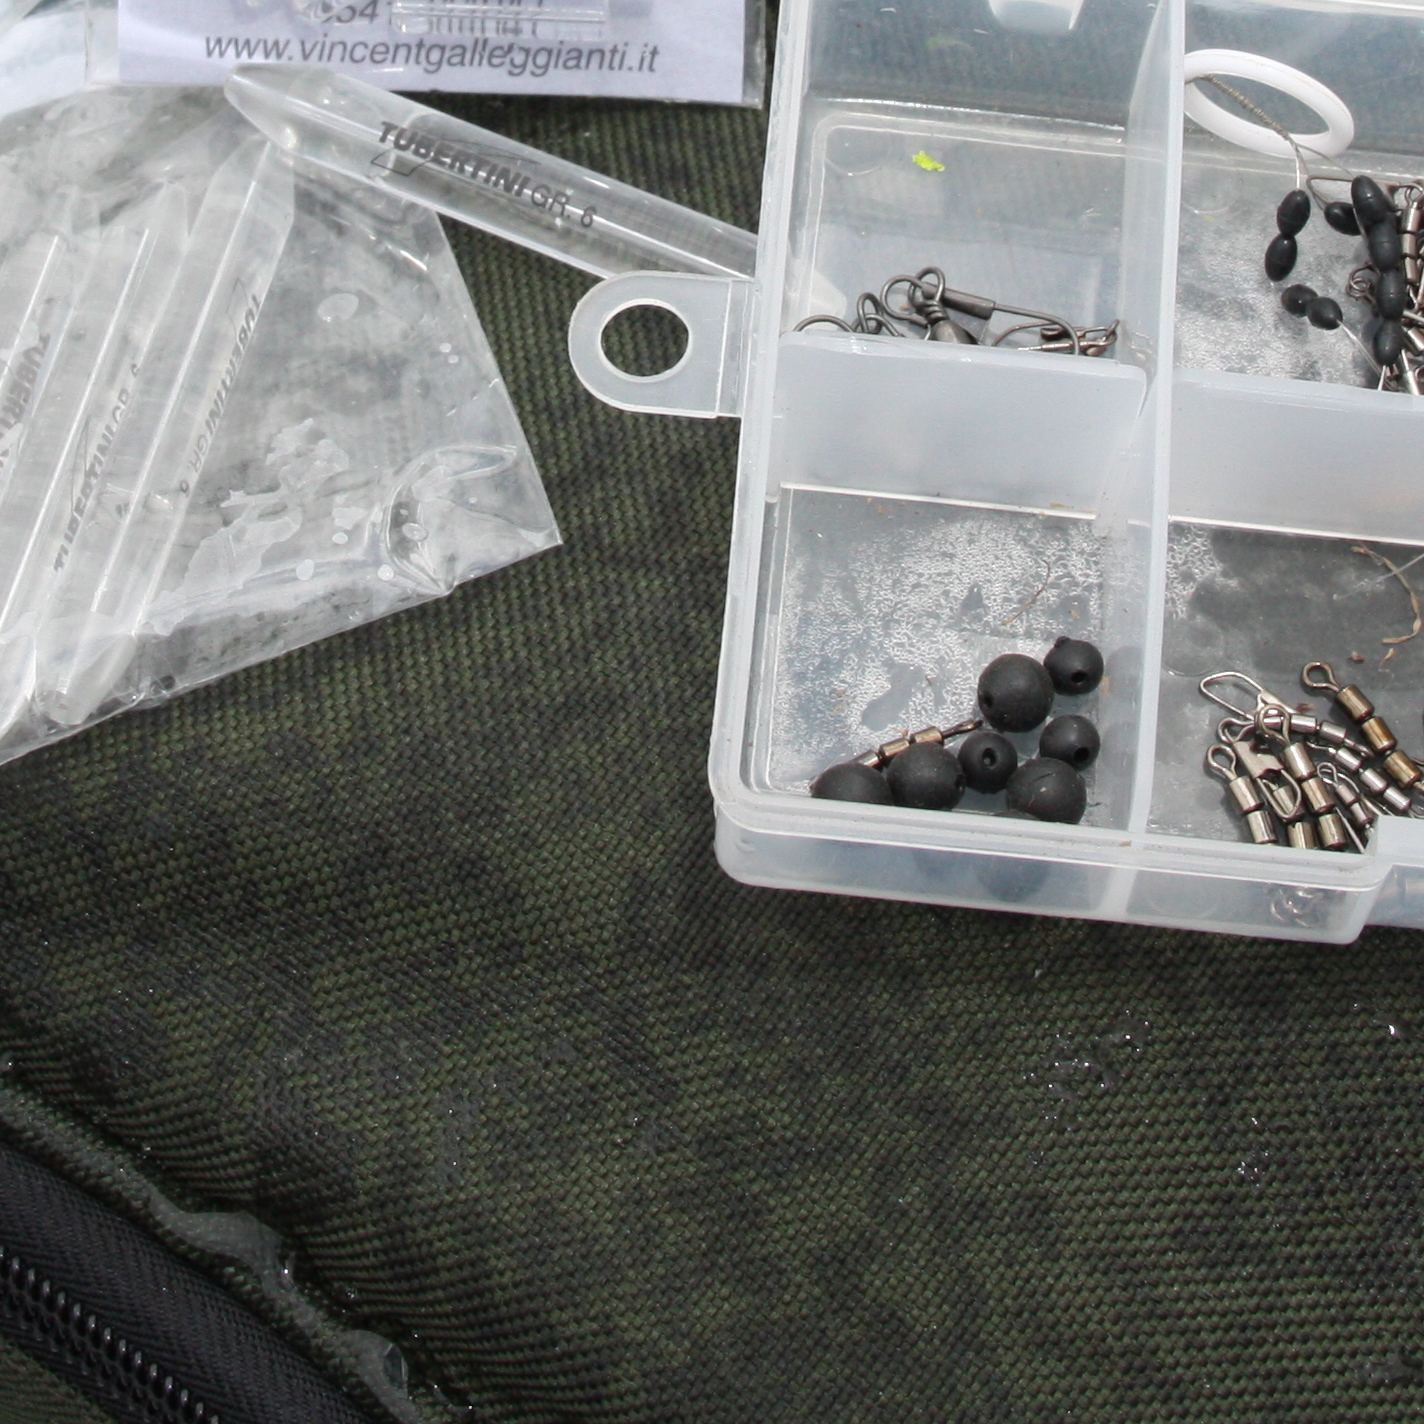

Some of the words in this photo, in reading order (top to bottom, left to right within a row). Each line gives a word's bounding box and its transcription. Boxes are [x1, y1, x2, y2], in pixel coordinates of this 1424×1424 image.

[204, 33, 660, 77] www.vincentgalleggianti.it
[379, 121, 531, 197] TUBERTINI
[531, 184, 572, 220] GR.
[580, 205, 597, 227] 6
